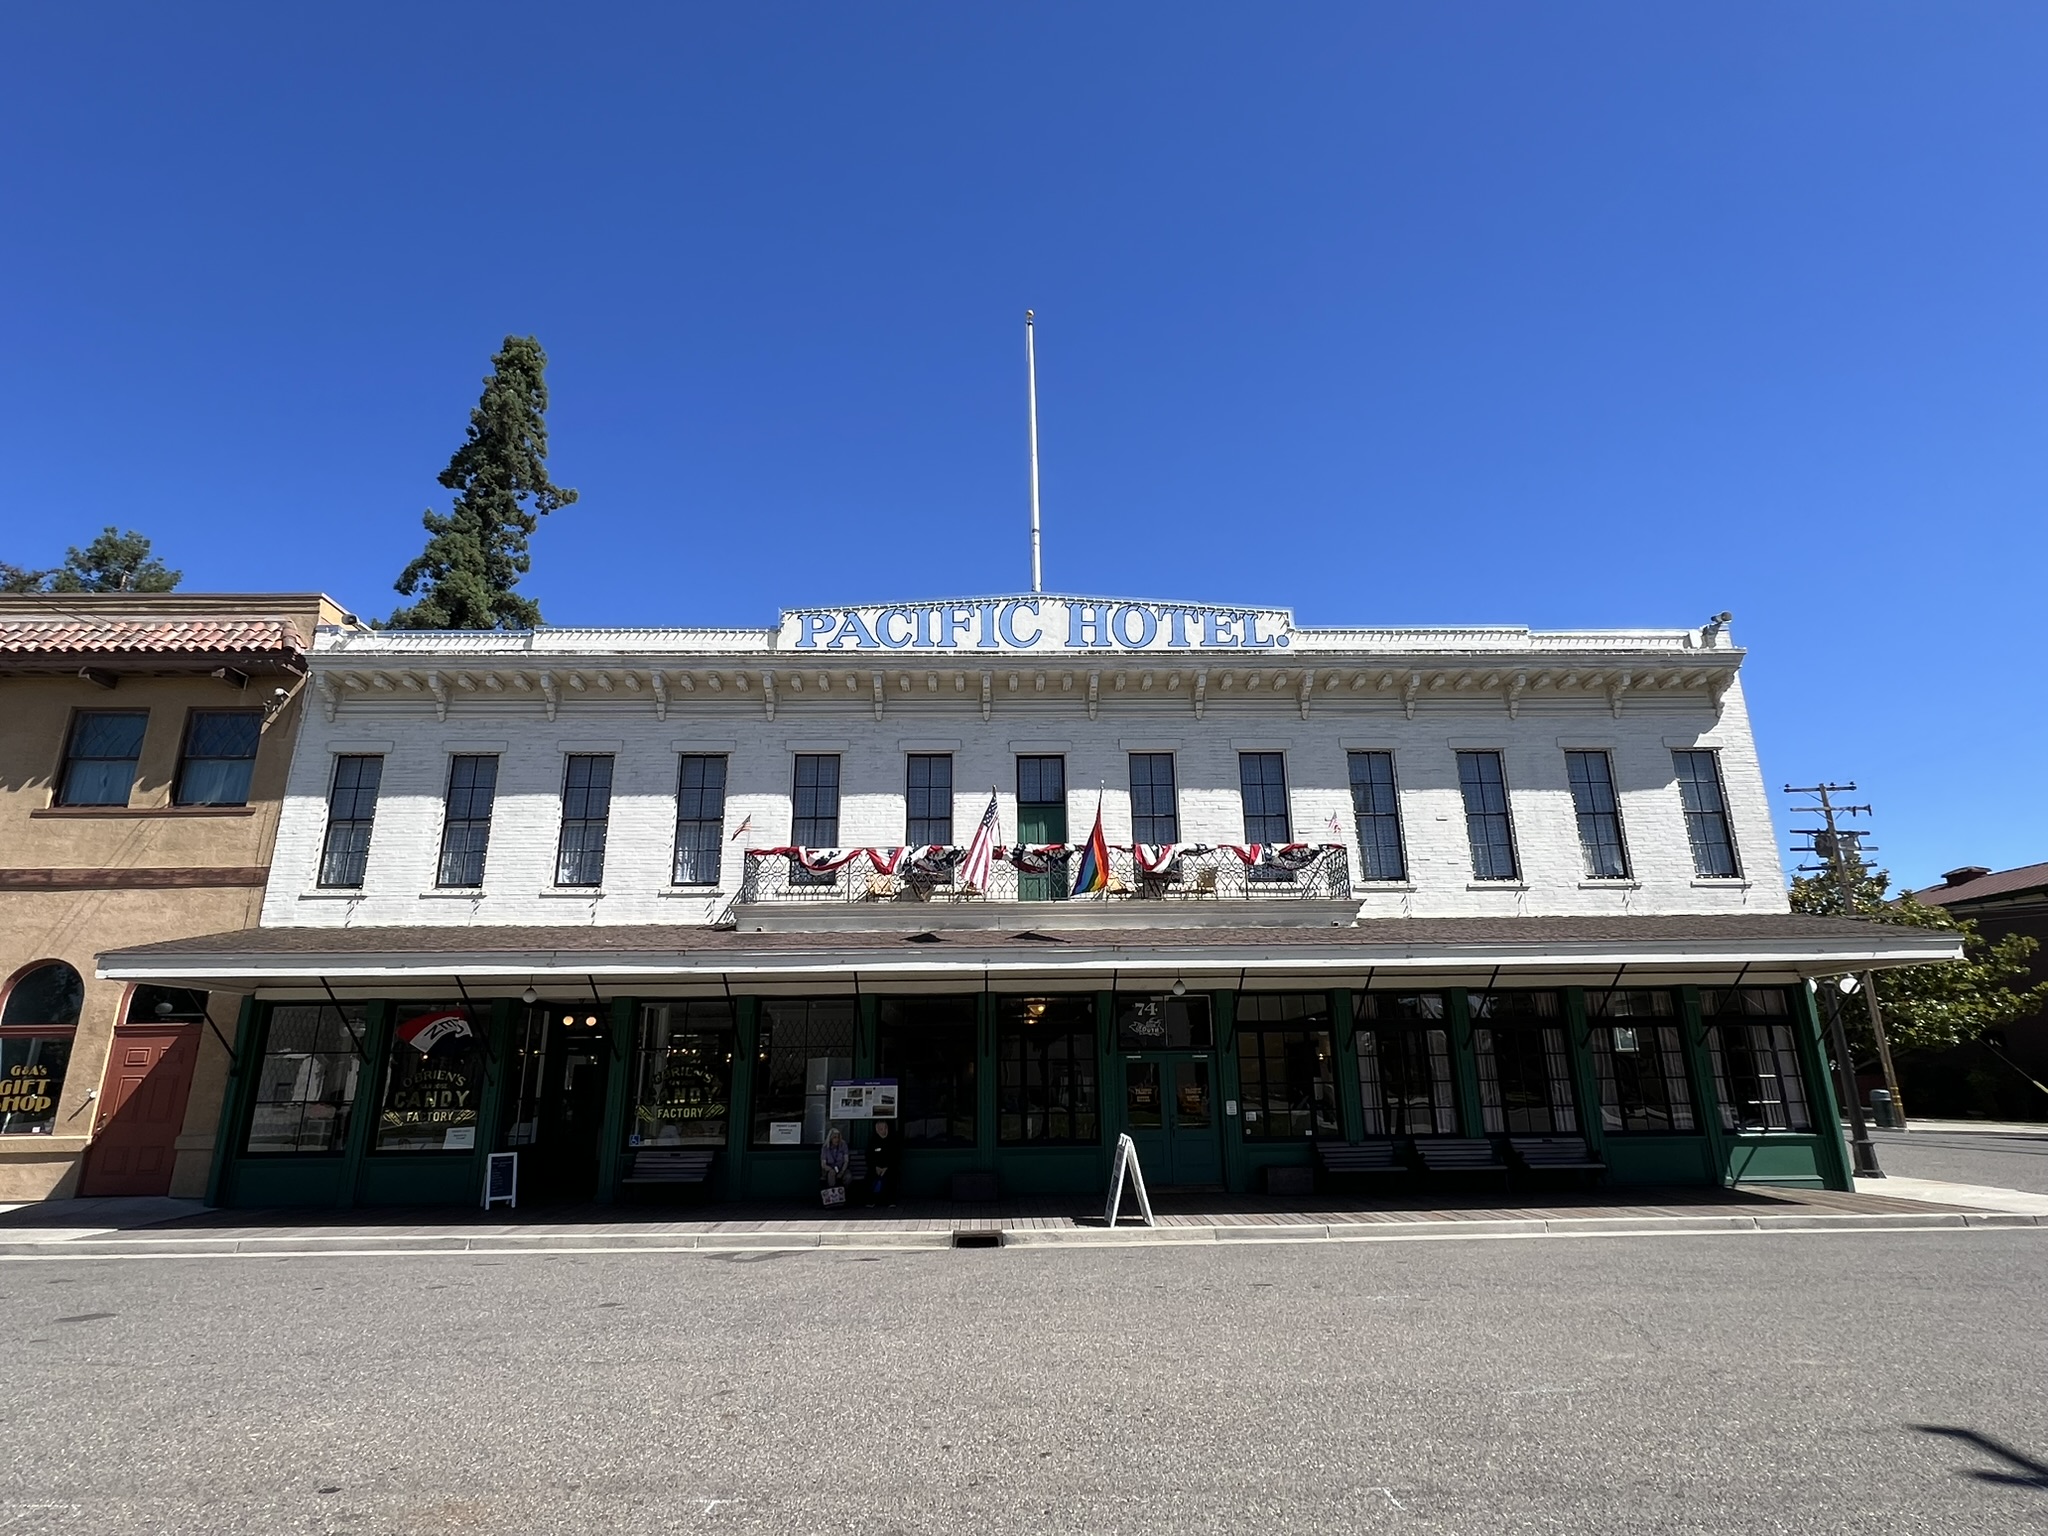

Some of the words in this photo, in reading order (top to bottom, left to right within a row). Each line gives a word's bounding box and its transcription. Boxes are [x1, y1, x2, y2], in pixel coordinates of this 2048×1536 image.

[796, 602, 1042, 648] PACIFIC
[1065, 603, 1290, 648] HOTEL.
[1134, 1002, 1158, 1016] 74
[402, 1069, 467, 1087] O'BRIEN'S
[0, 1079, 51, 1095] GIFT
[394, 1090, 470, 1108] CANDY
[643, 1086, 719, 1105] CANDY
[0, 1096, 52, 1112] HOP
[406, 1110, 454, 1122] FACTORY
[657, 1107, 704, 1118] FACTORY
